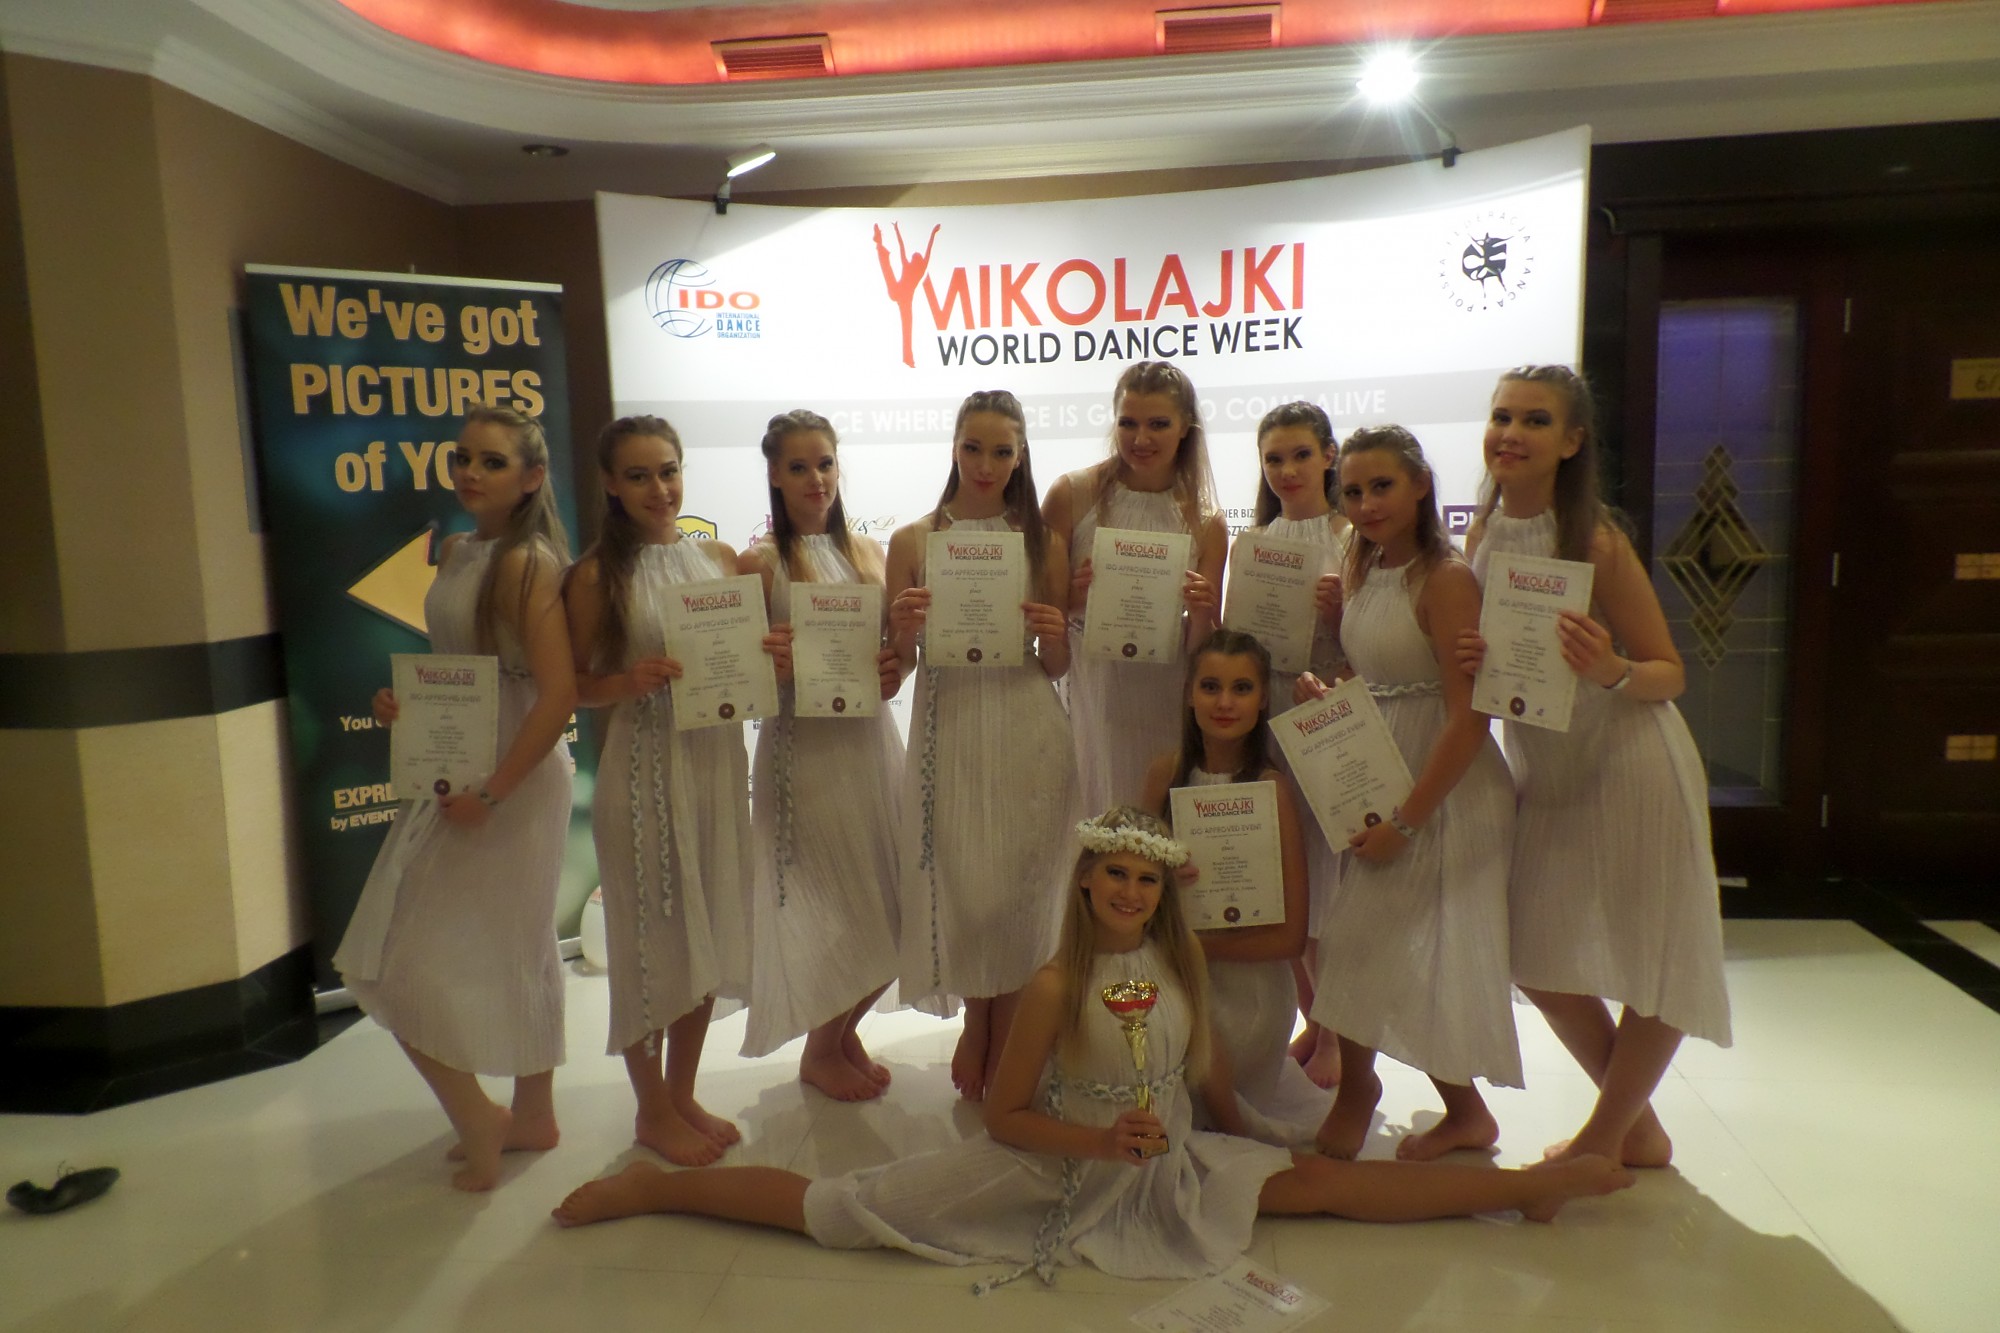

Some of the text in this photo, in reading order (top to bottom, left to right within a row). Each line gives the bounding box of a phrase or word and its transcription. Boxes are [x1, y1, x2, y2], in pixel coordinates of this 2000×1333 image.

[922, 242, 1305, 331] MIKOLAJKI
[678, 289, 760, 310] IDO
[279, 283, 541, 355] We've got
[717, 319, 760, 331] DANCE
[937, 316, 1304, 366] WORLD DANCE WEEK
[290, 363, 545, 418] PICTURES
[871, 408, 953, 433] WHERE
[1059, 404, 1078, 427] IS
[335, 441, 457, 492] of YO
[954, 546, 1003, 556] MIKOLAJKI
[1119, 543, 1168, 556] MIKOLAJKI
[690, 593, 741, 608] MIKOLAJKI
[339, 715, 373, 731] You
[1303, 700, 1352, 731] MIKOLAJKI
[1200, 800, 1254, 813] MIKOLAJKI
[330, 816, 348, 832] by
